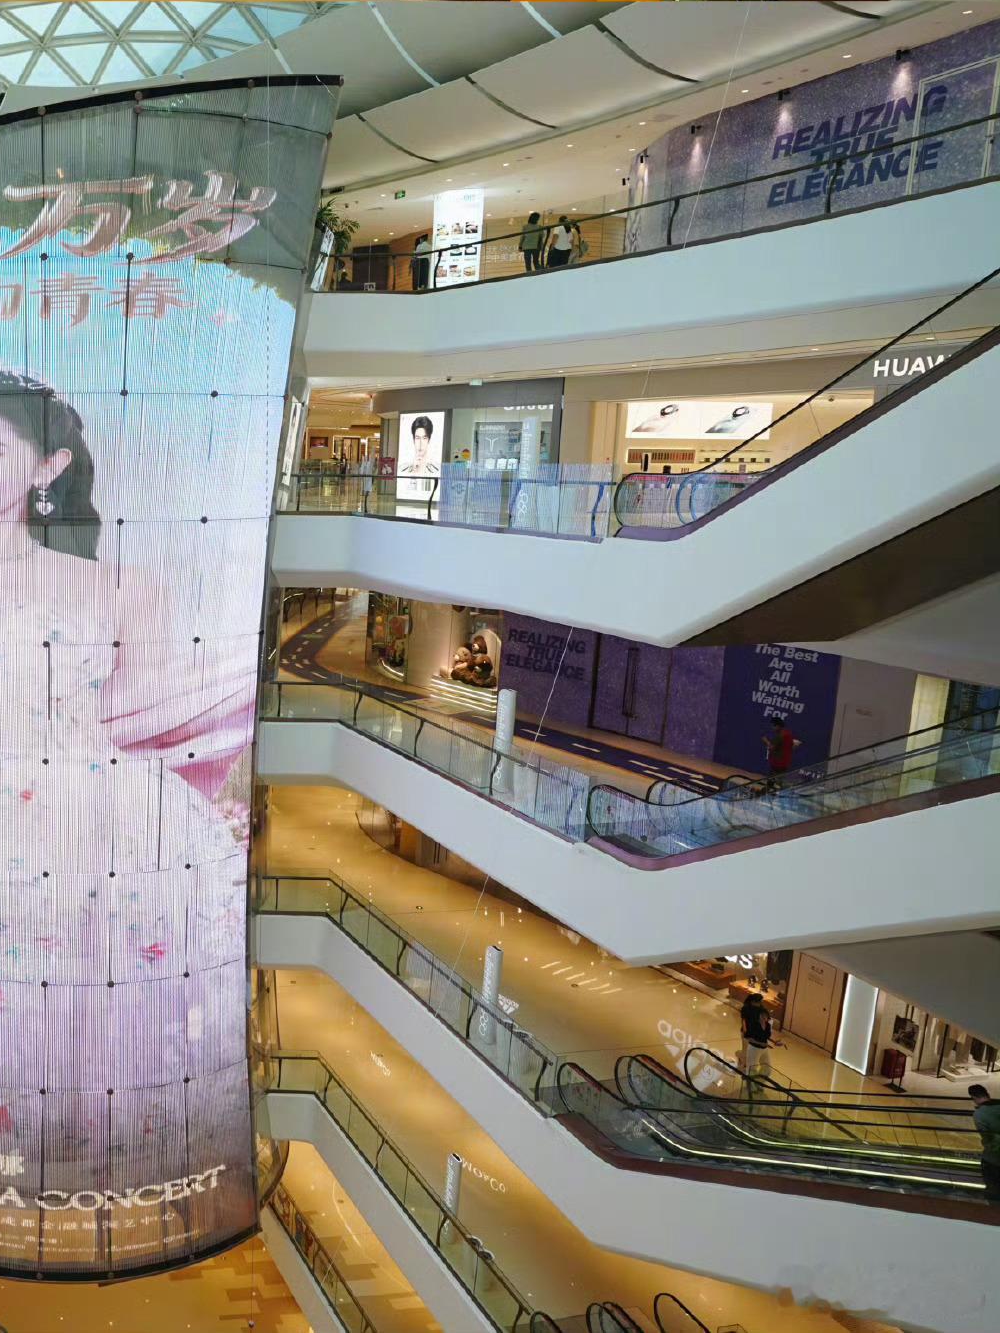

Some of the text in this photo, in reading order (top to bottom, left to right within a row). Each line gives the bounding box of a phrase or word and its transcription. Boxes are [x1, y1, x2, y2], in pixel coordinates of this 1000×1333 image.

[772, 84, 948, 160] REALIZING
[809, 126, 898, 172] TRUE
[767, 141, 943, 208] ELEGANCE
[508, 628, 586, 654] REALIZING
[527, 645, 565, 663] TRUE
[754, 643, 819, 663] The Best
[768, 657, 794, 672] Are
[505, 653, 585, 681] ELEGANCE
[770, 672, 791, 683] All
[758, 679, 800, 698] Worth
[752, 691, 805, 714] Waiting
[764, 706, 789, 721] For
[34, 1164, 227, 1211] CONCERT
